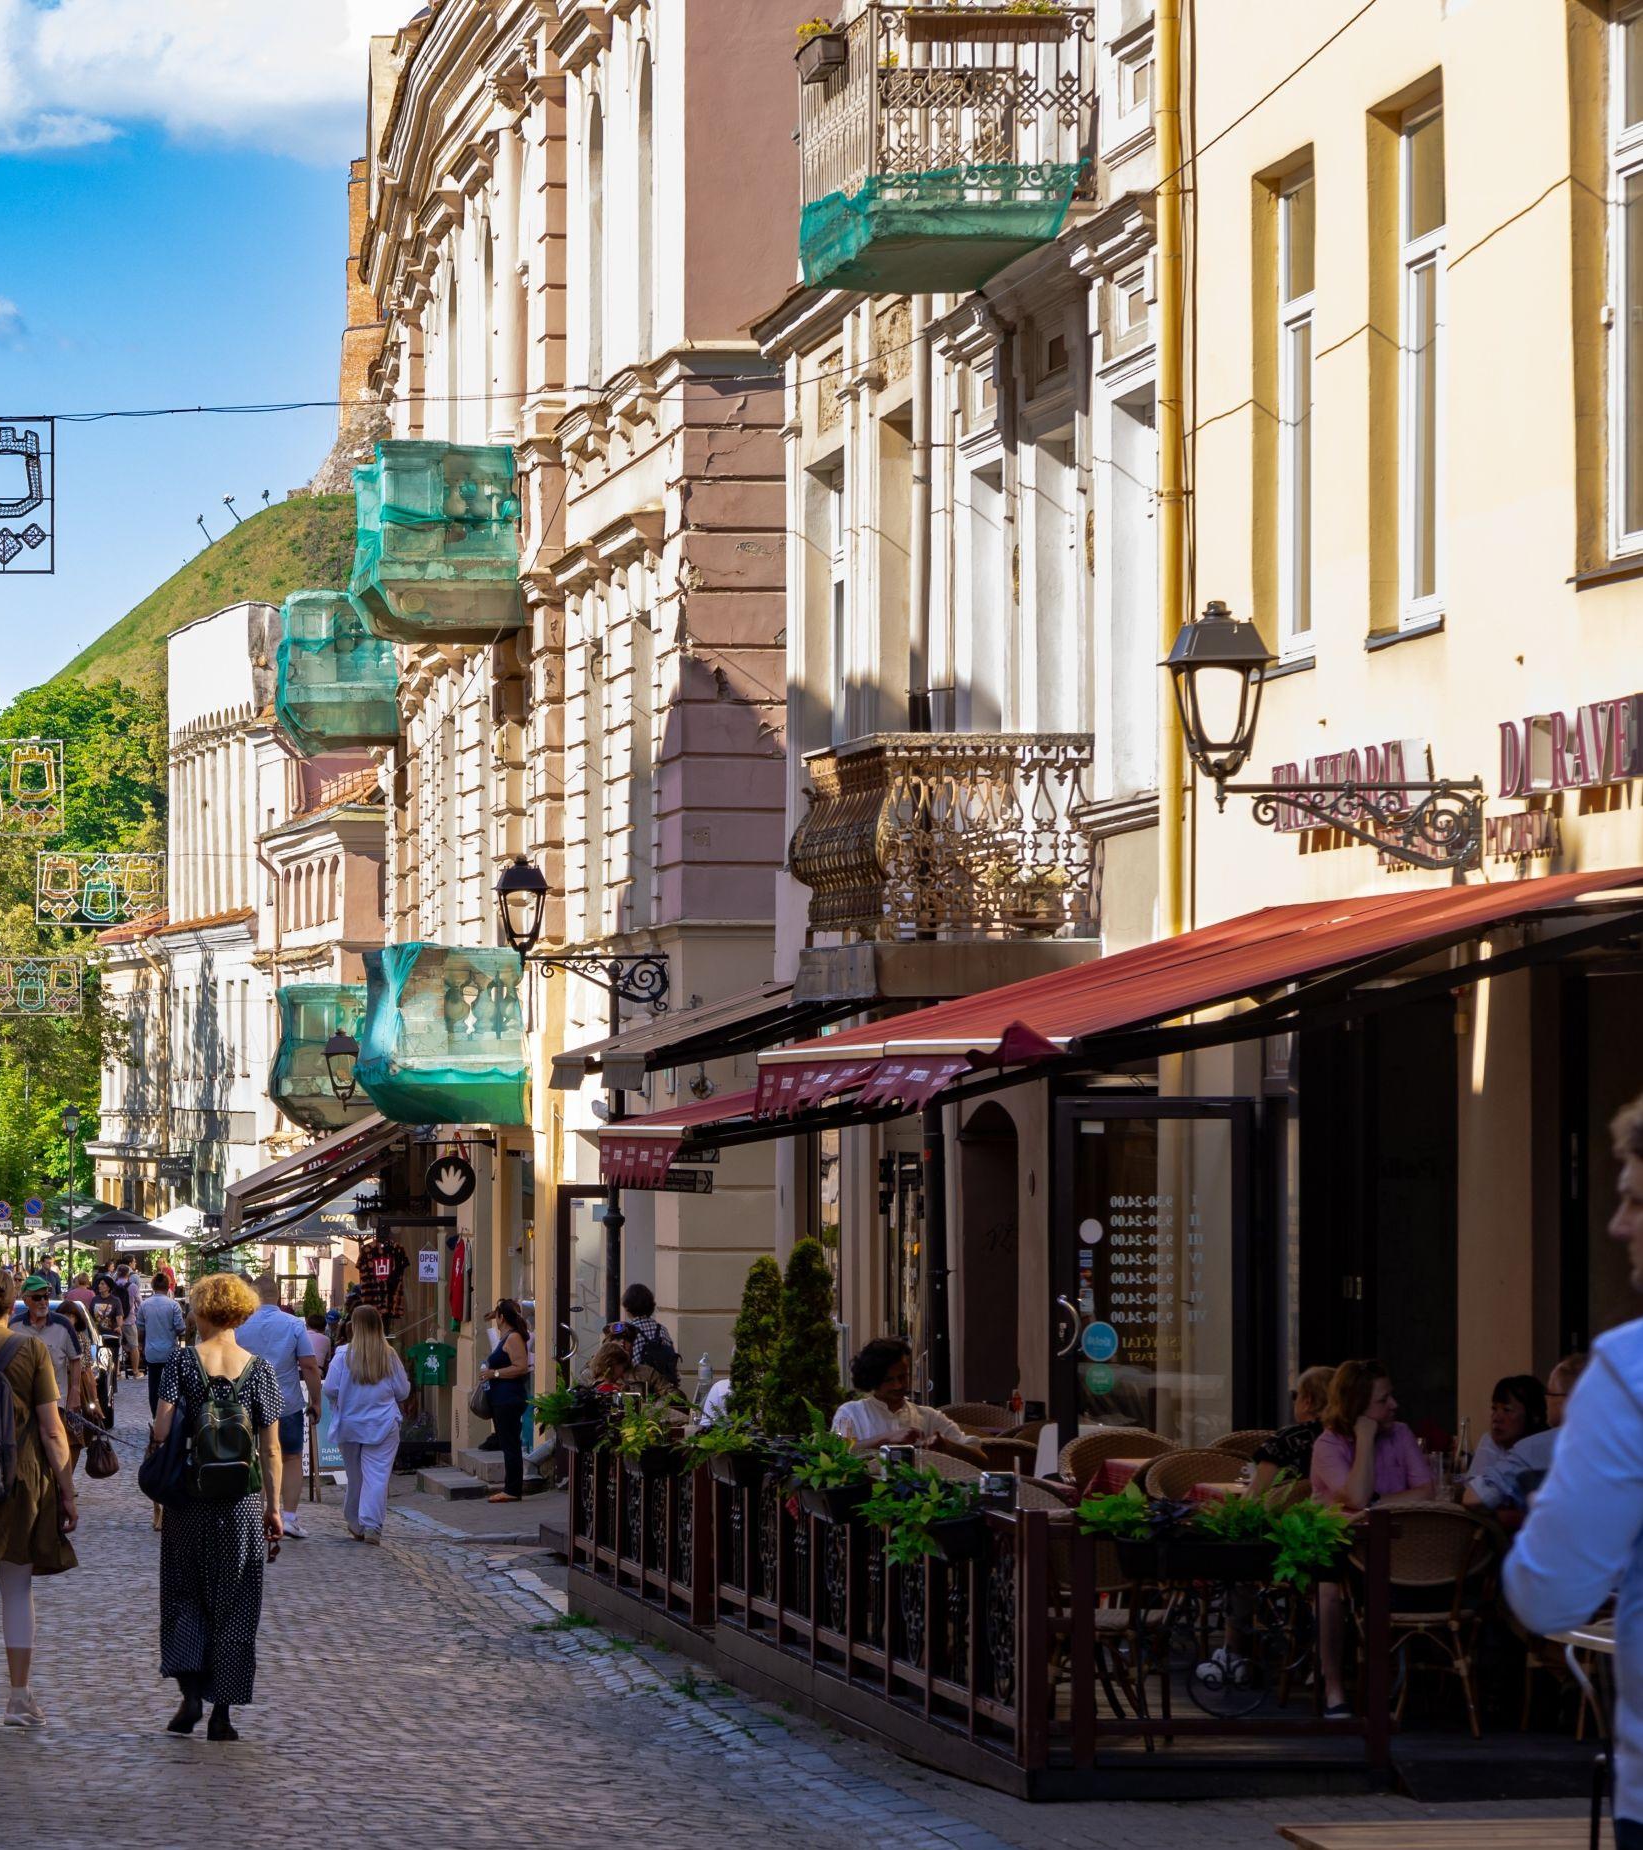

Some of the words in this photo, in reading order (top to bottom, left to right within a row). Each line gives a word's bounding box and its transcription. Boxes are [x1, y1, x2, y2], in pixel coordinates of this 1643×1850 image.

[1272, 740, 1411, 832] TRATTORIA
[1499, 716, 1534, 799] DI
[1550, 693, 1643, 791] RAVE
[320, 1213, 355, 1223] Volfa
[420, 1253, 438, 1263] OPEN
